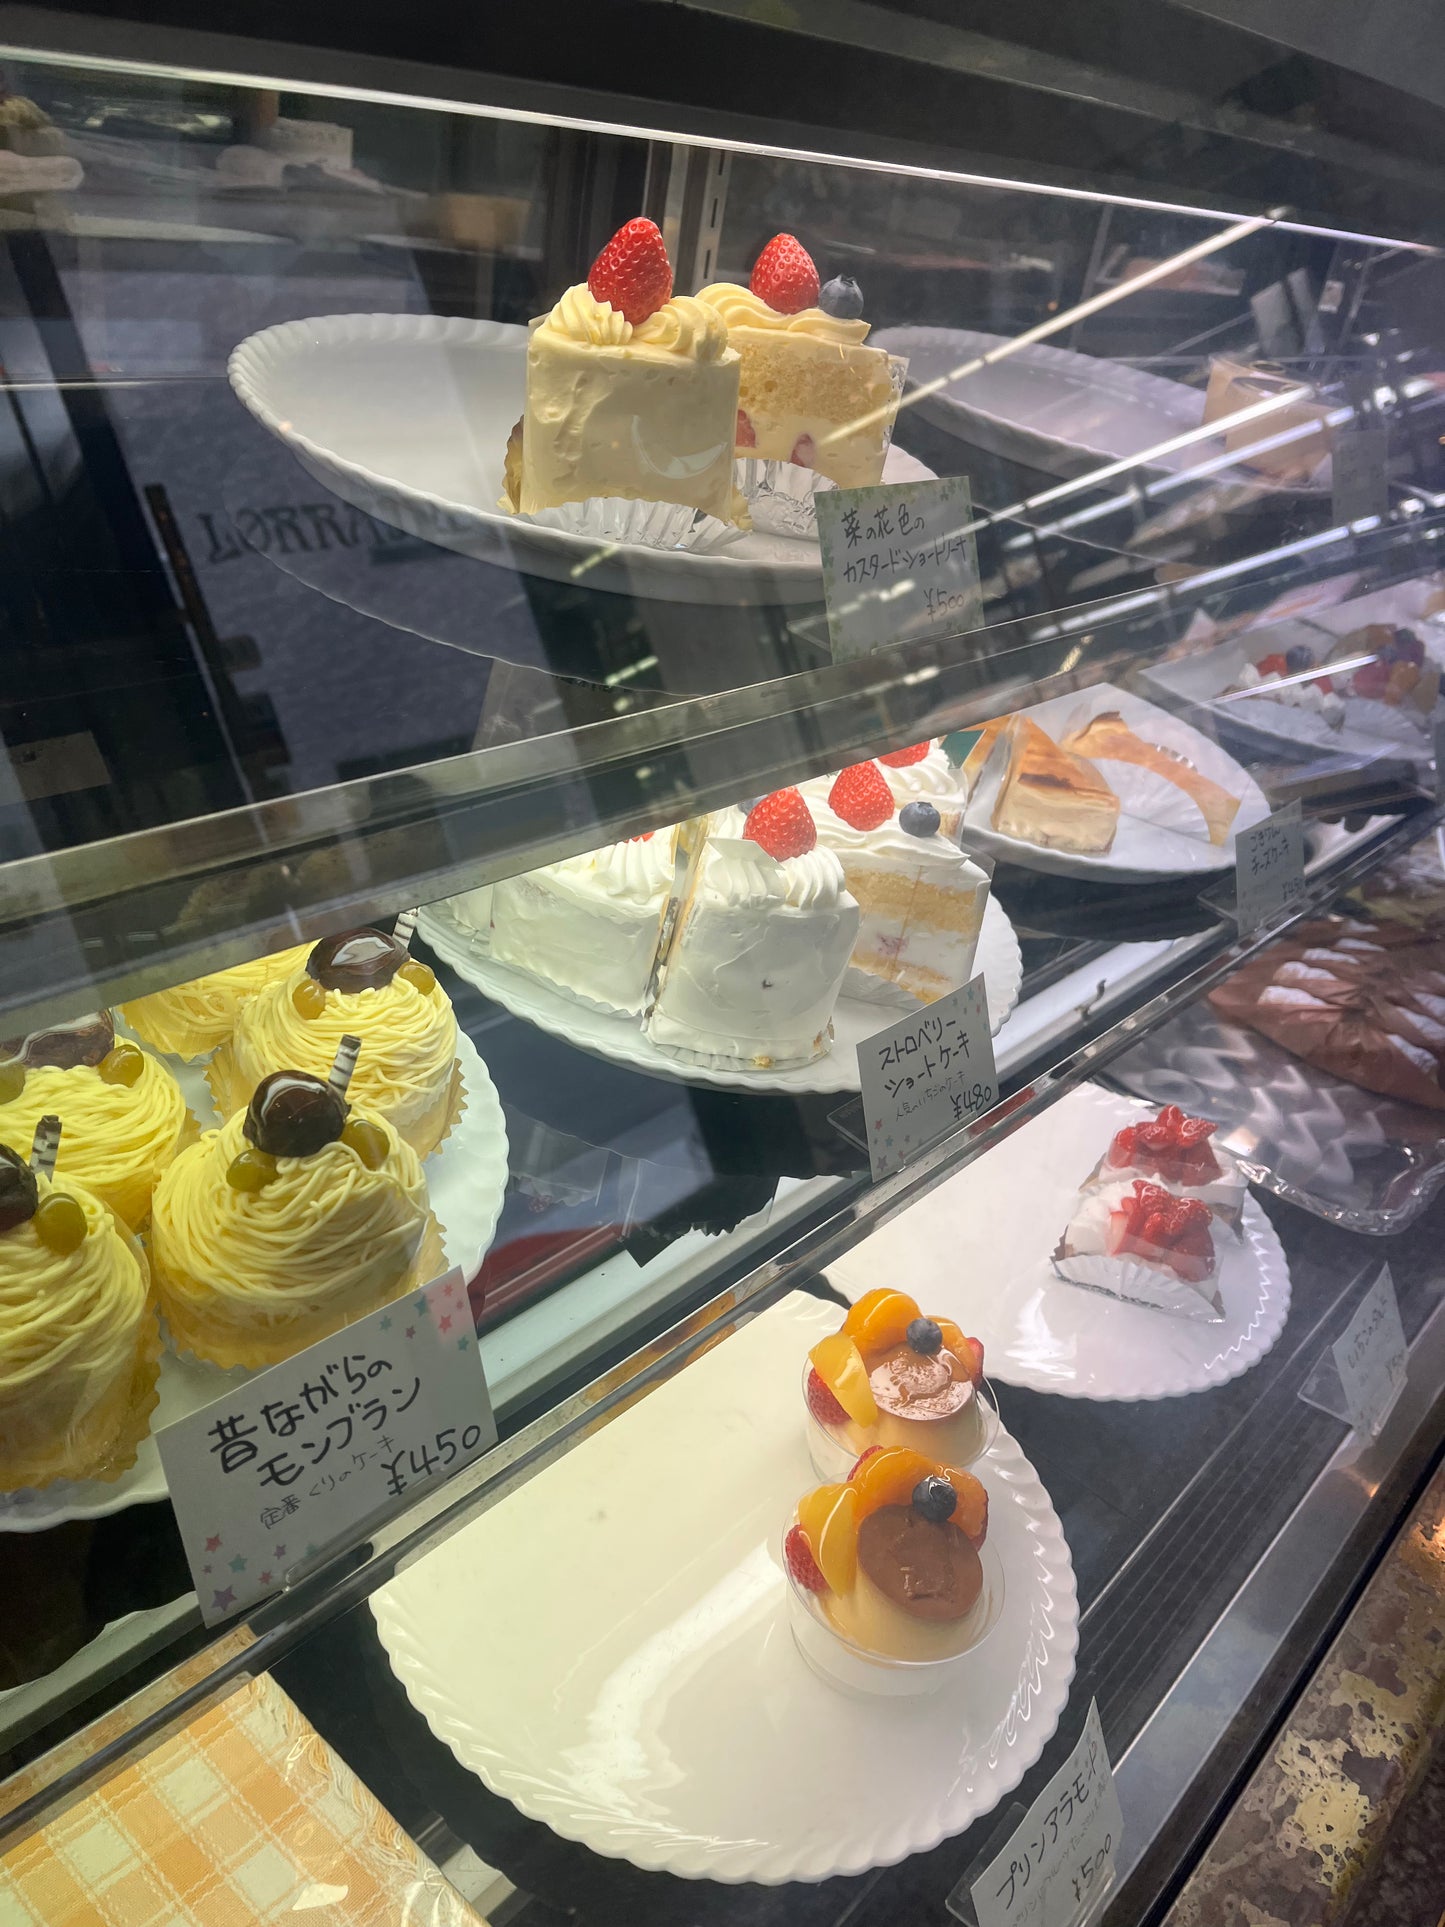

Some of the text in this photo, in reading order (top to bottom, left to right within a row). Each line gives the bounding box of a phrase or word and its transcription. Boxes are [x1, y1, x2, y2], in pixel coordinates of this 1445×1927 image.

[841, 503, 925, 549] 菜の花色の
[923, 587, 964, 622] ¥500
[879, 1017, 956, 1070] ストロベリー
[884, 1030, 970, 1098] ショートケーキ
[950, 1083, 992, 1120] ¥480
[208, 1354, 393, 1473] 昔ながらの
[257, 1377, 421, 1487] モンブラン
[380, 1425, 481, 1496] ¥450
[1072, 1833, 1112, 1902] ¥500
